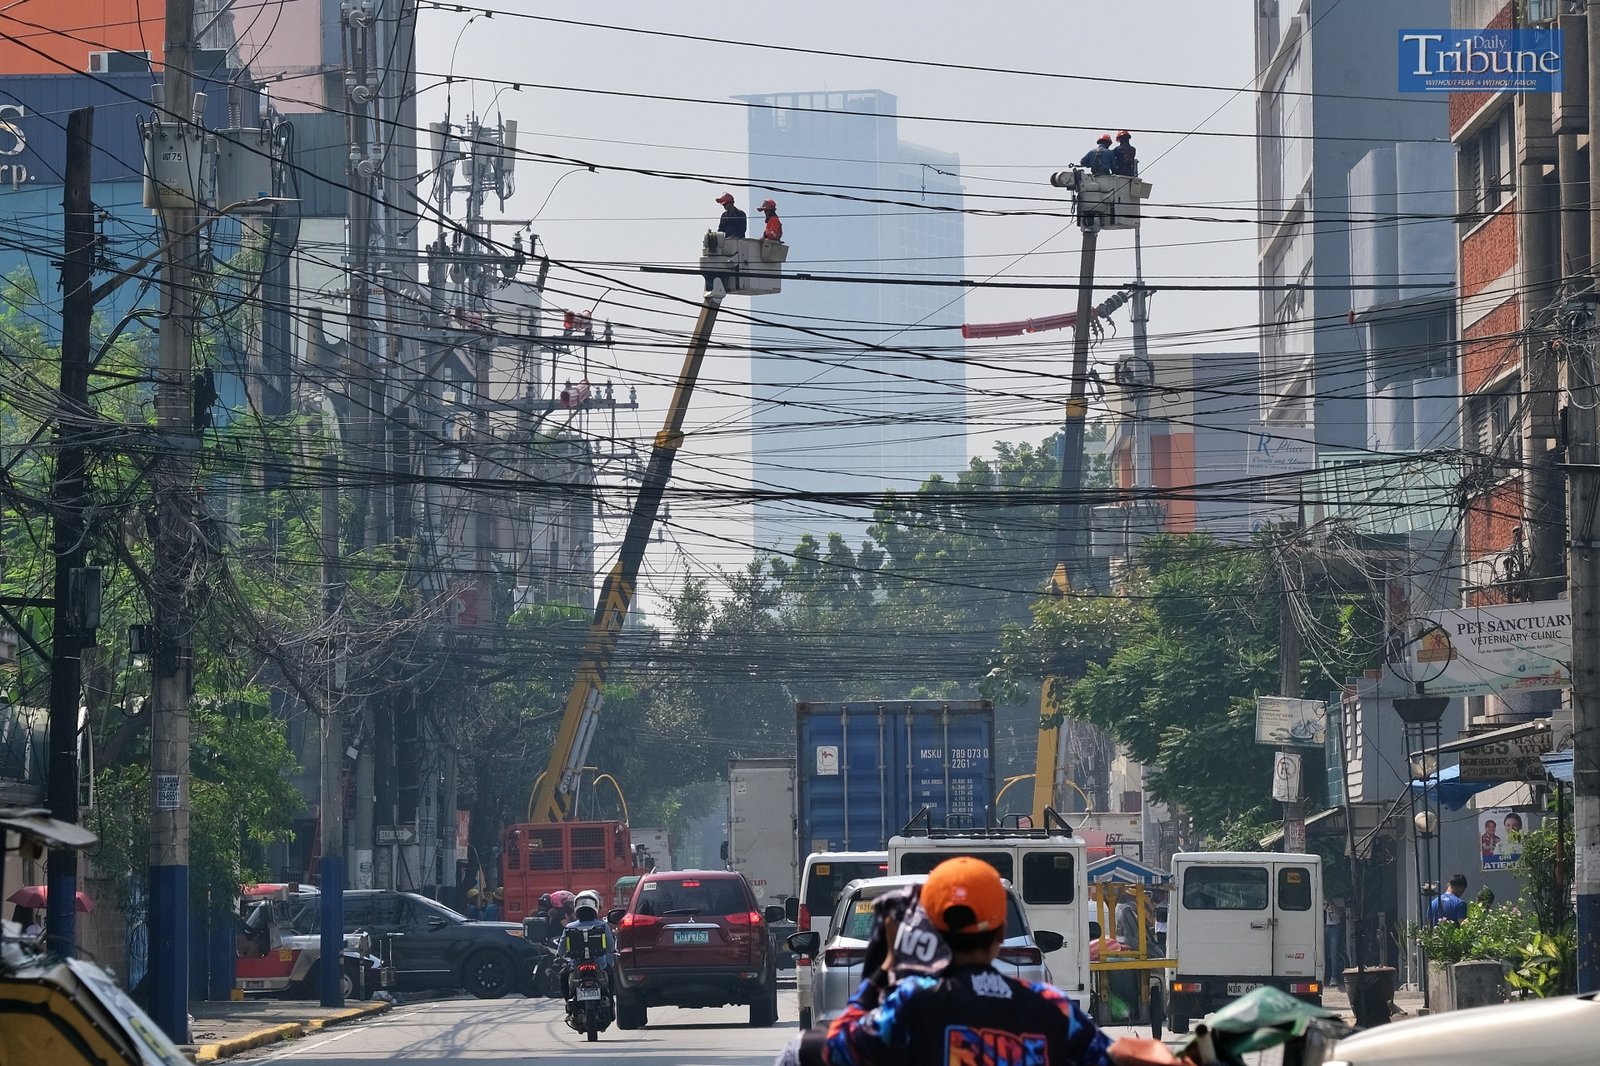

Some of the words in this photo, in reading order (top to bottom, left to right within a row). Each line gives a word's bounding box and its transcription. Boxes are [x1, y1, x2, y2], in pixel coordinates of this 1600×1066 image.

[172, 153, 182, 161] 75
[1257, 432, 1274, 457] R
[1457, 621, 1484, 635] PET
[1488, 614, 1572, 632] SANCTUARY
[1471, 632, 1528, 646] VETERINARY
[1531, 630, 1562, 640] CLINIC
[920, 749, 942, 759] MSKU
[952, 749, 965, 758] 789
[967, 749, 981, 758] 073
[952, 759, 970, 768] 22G1
